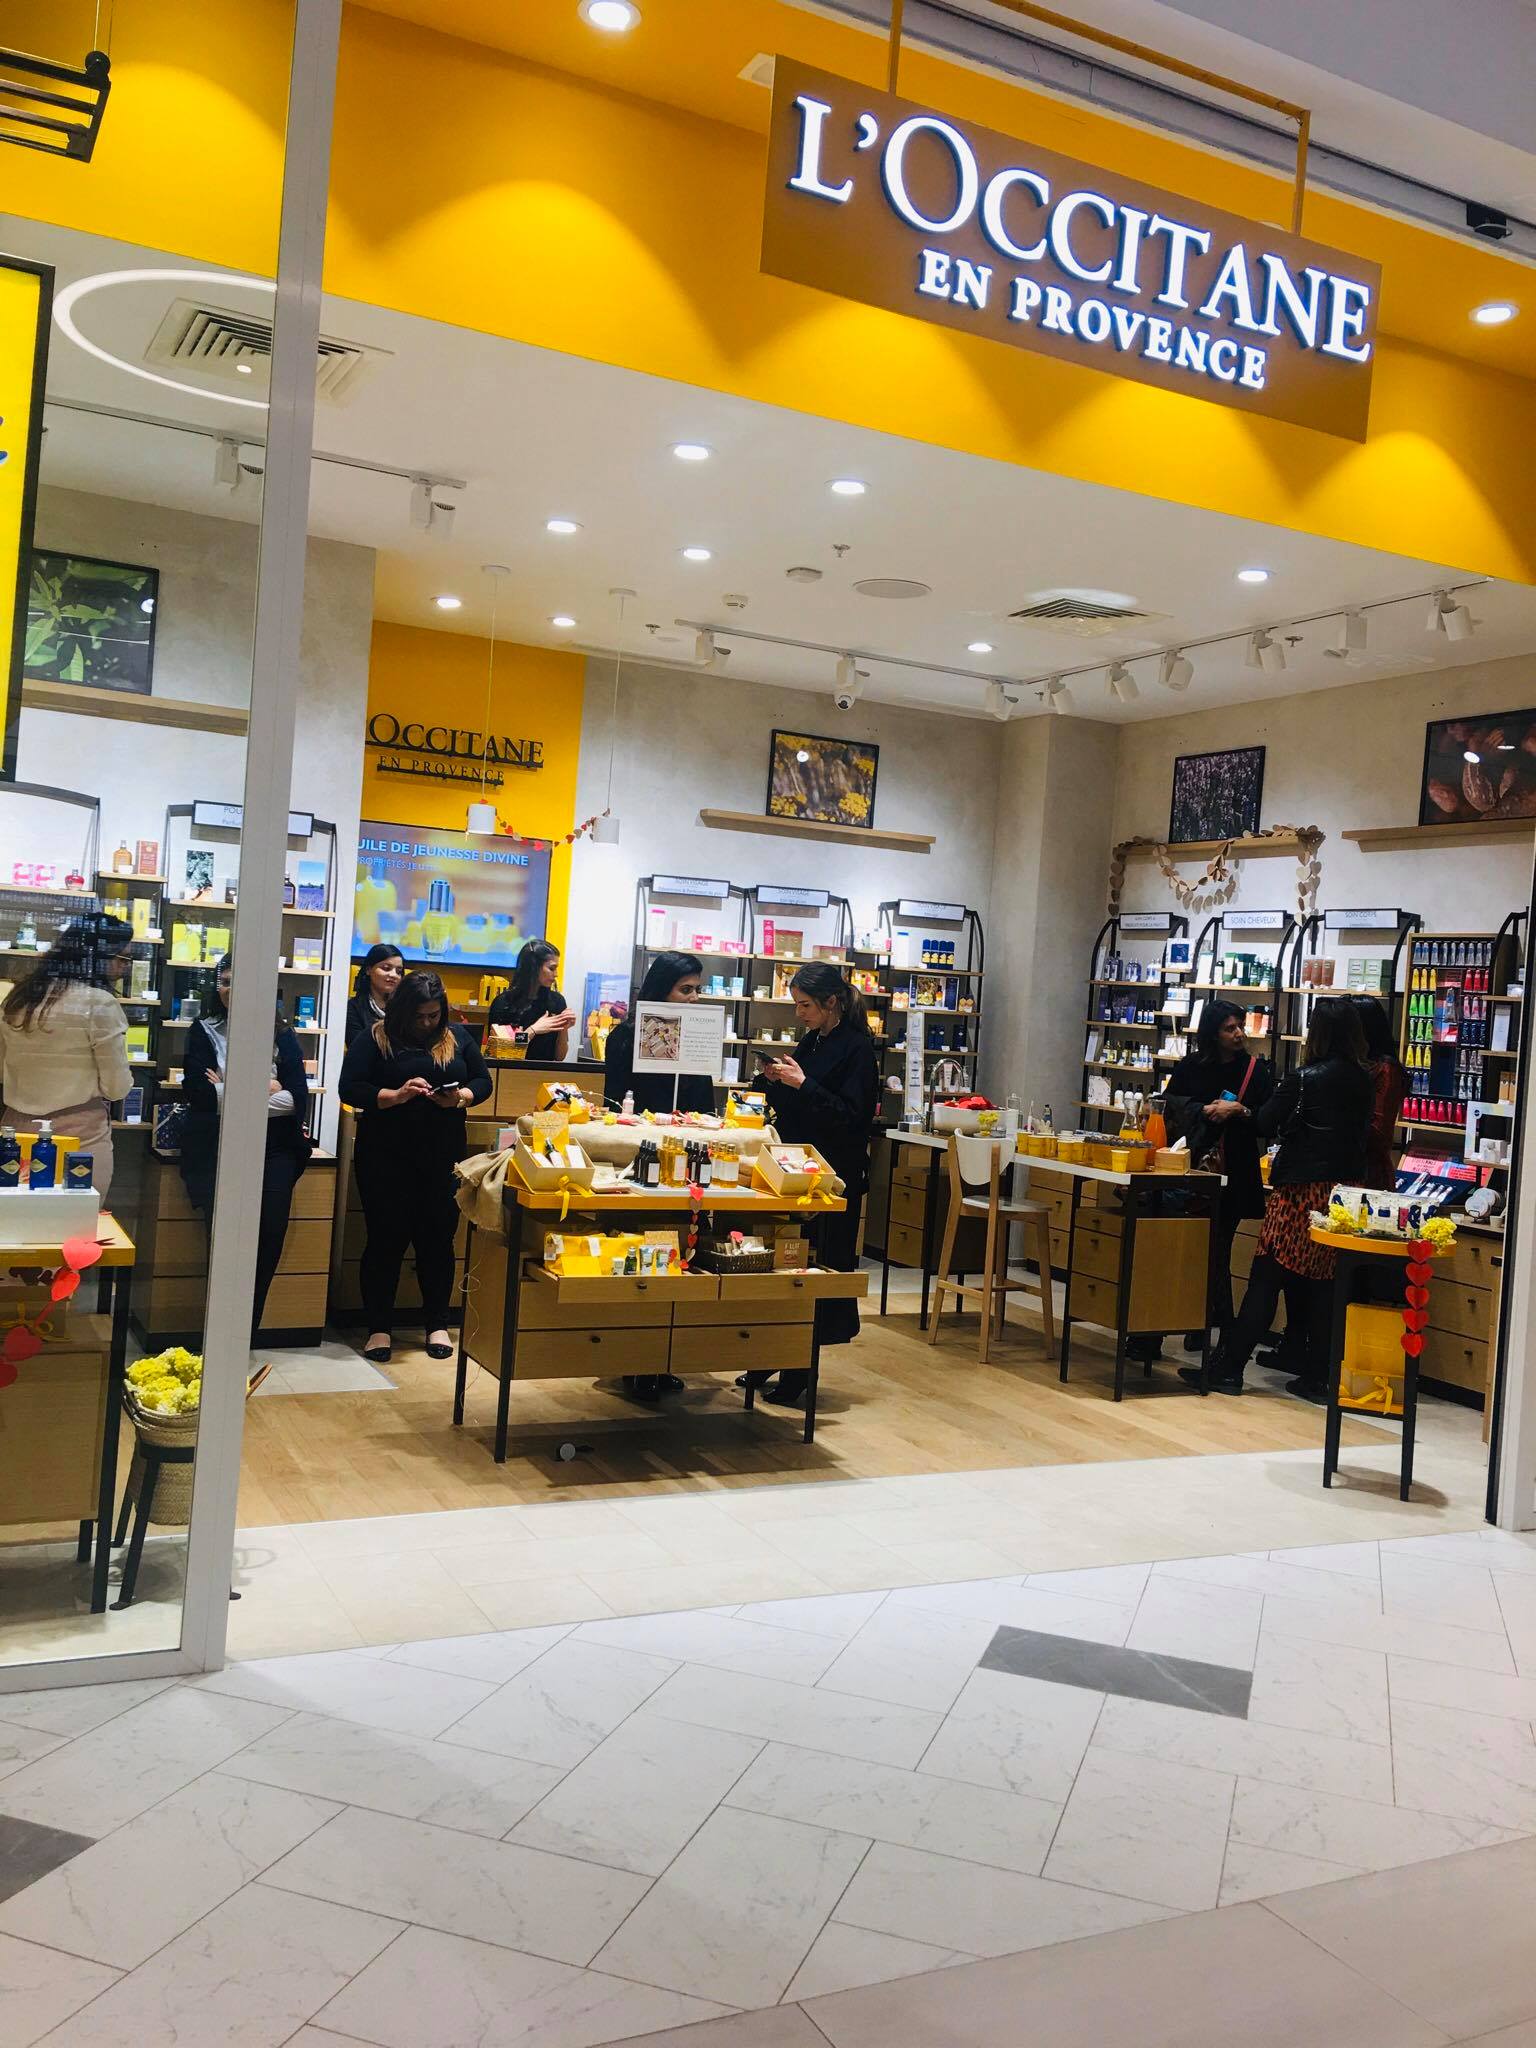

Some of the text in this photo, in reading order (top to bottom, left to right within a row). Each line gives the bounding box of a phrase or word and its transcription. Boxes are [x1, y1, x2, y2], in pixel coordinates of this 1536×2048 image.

[918, 248, 1268, 392] EN PROVENCE
[369, 713, 544, 766] OCCITANE
[379, 755, 505, 781] EN PROVENCE
[223, 806, 243, 814] POU
[390, 841, 410, 854] DE
[412, 844, 479, 861] JEUNESSE
[483, 851, 529, 866] DIVINE
[1230, 916, 1277, 925] SOIN CHEVEUX
